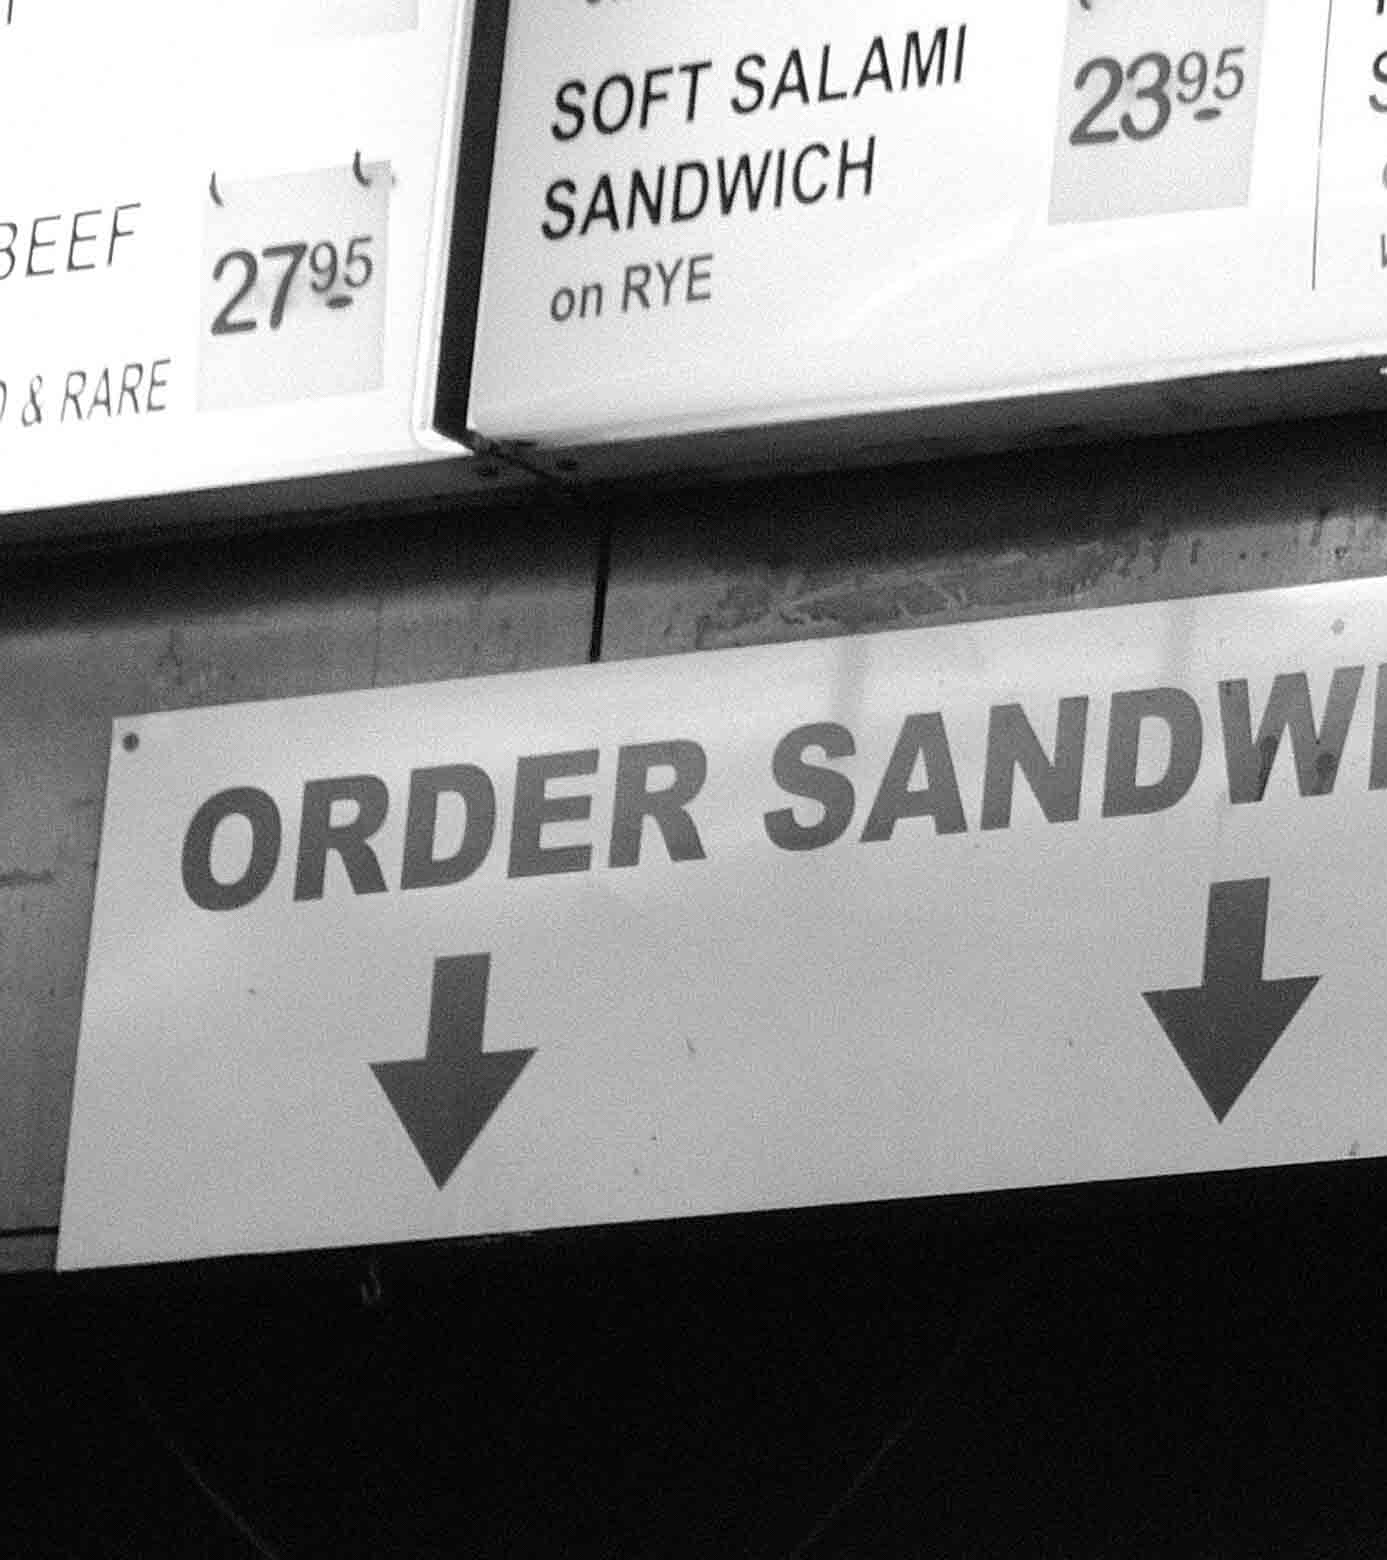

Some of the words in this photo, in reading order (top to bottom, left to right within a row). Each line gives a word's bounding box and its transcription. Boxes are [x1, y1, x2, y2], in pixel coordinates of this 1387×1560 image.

[550, 60, 713, 143] SOFT
[730, 23, 968, 116] SALAMI
[540, 135, 878, 241] SANDWICH
[549, 281, 604, 323] on
[620, 251, 715, 311] RYE
[60, 357, 172, 424] RARE
[179, 738, 709, 913] ORDER
